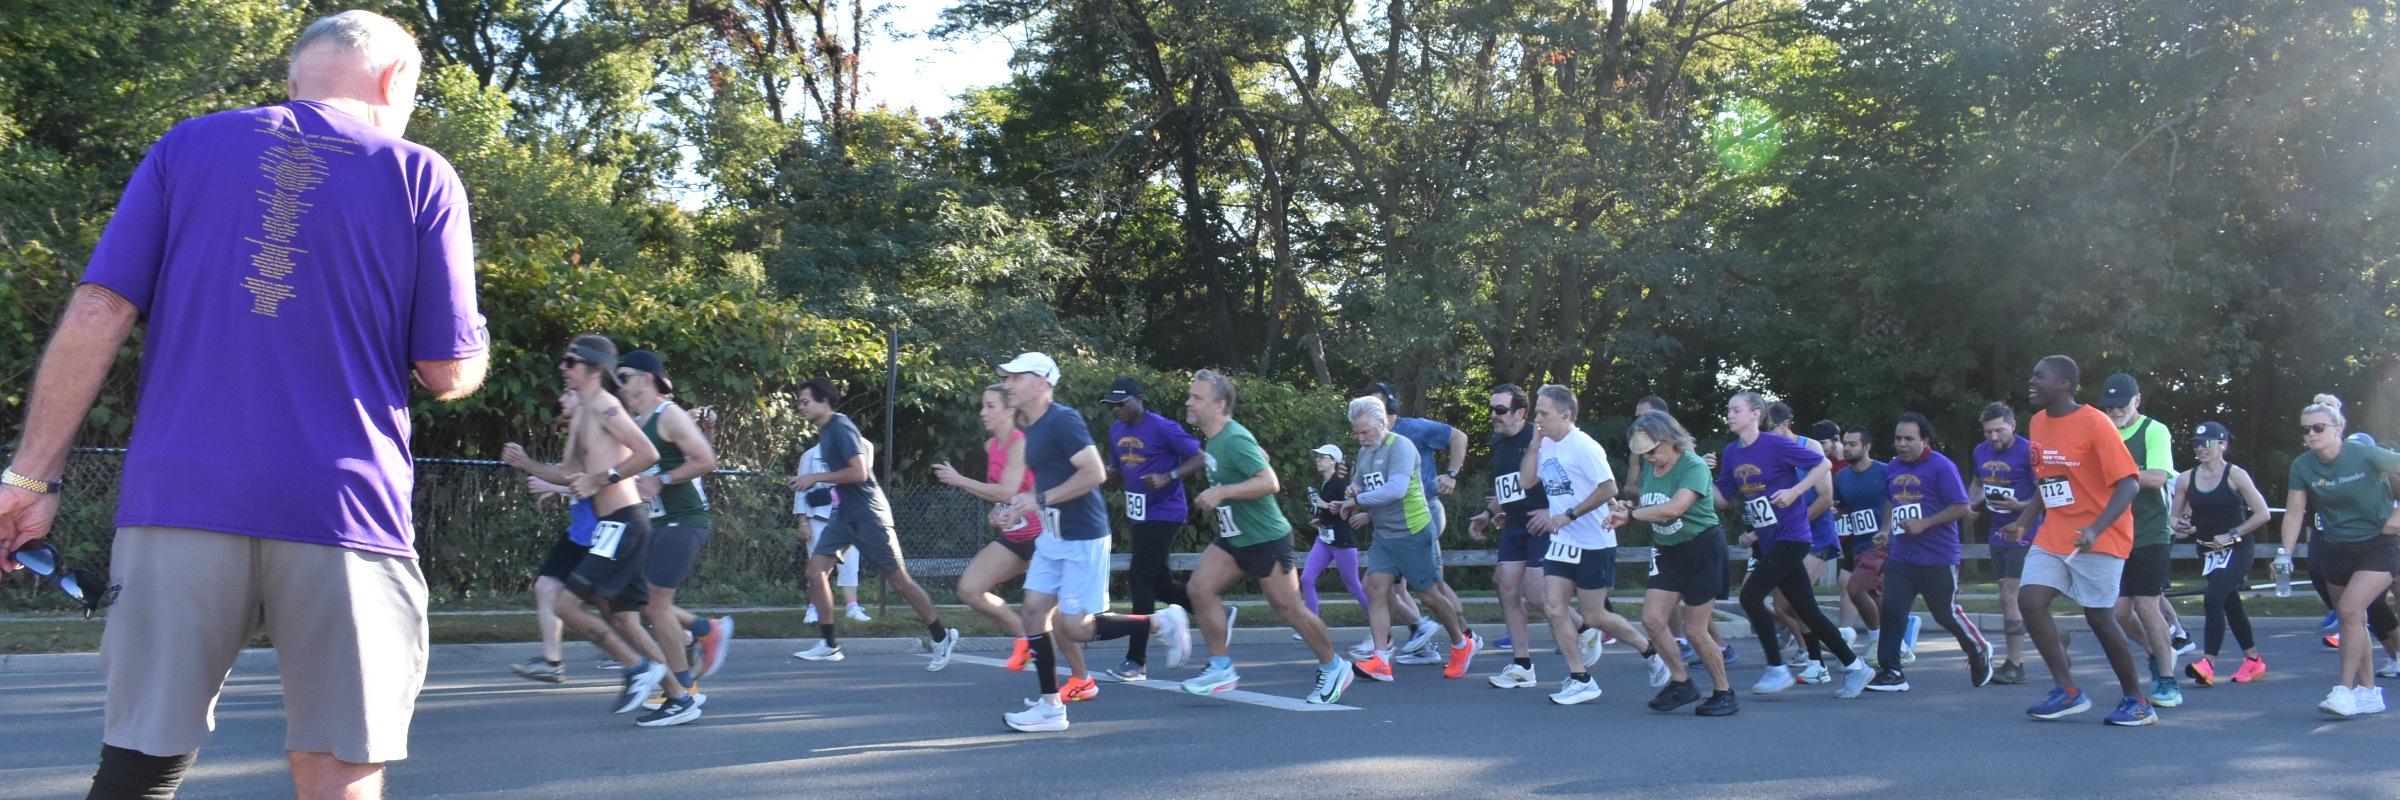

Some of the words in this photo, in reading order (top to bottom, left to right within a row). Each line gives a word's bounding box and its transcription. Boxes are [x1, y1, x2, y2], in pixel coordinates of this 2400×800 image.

[1496, 475, 1521, 501] 164
[2042, 483, 2065, 498] 712
[1852, 511, 1875, 533] 160
